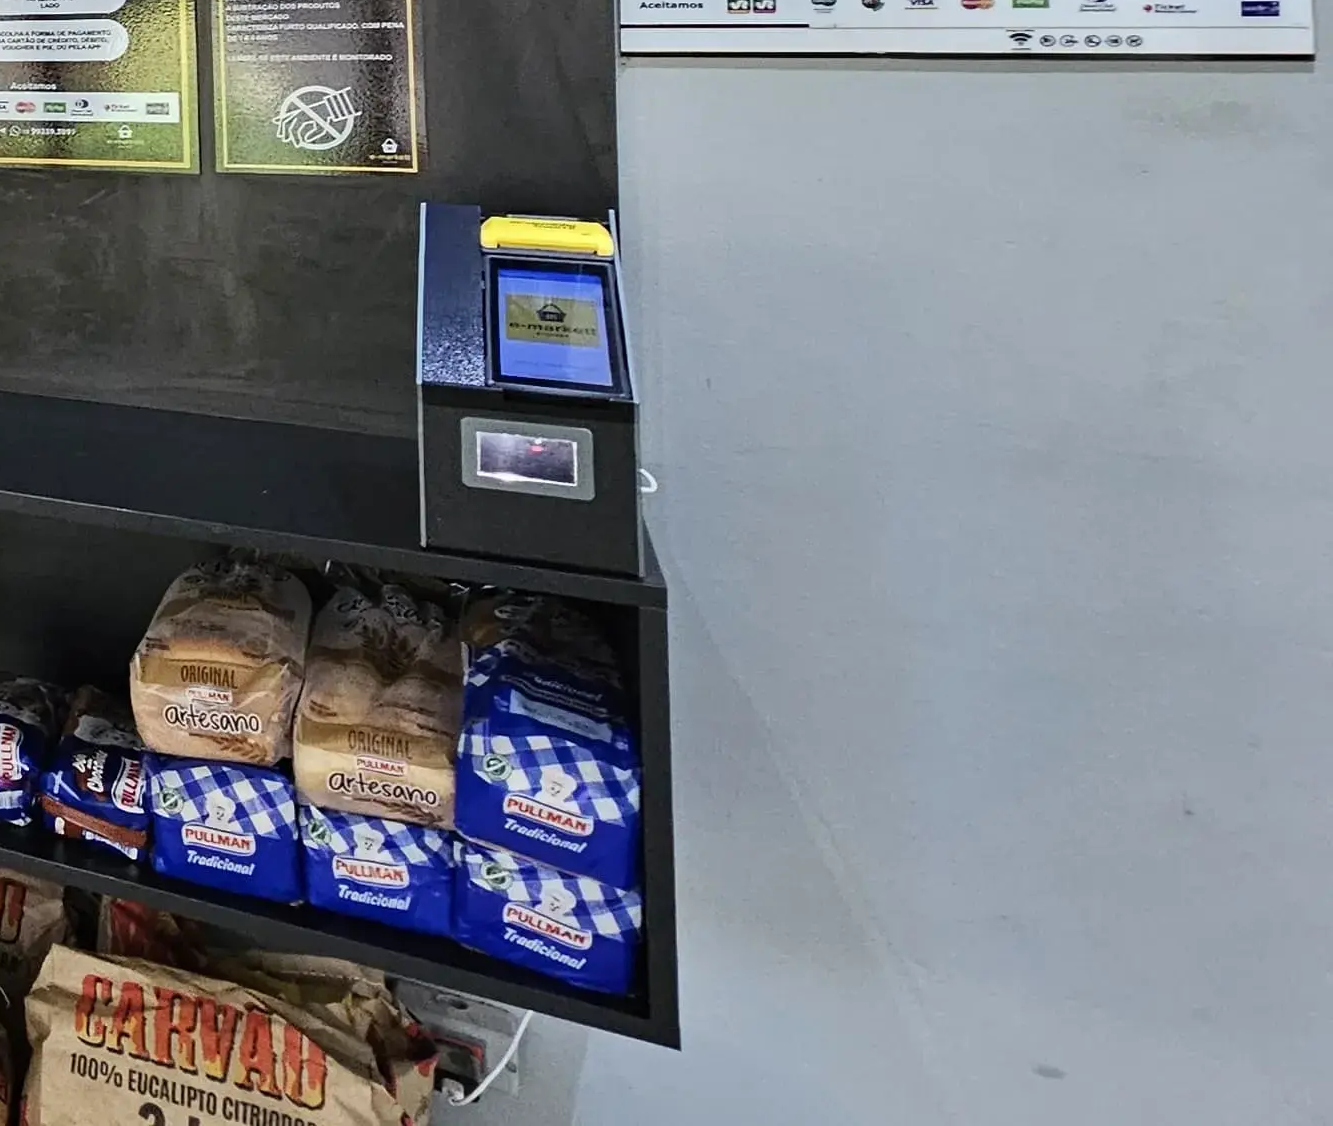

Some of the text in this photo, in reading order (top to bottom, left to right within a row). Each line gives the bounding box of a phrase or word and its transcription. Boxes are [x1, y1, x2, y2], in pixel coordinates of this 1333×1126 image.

[639, 0, 704, 11] Aceitamos
[180, 664, 238, 690] ORIGINAL
[164, 704, 260, 733] artesano
[348, 729, 413, 760] ORIGINAL
[328, 772, 438, 806] artesano
[507, 797, 590, 833] PULLMAN
[185, 827, 251, 851] PULLMAN
[504, 818, 587, 854] Tradicional
[186, 849, 255, 876] Tradicional
[336, 859, 405, 883] PULLMAN
[338, 884, 411, 911] Tradicional
[507, 906, 590, 945] PULLMAN
[504, 927, 587, 970] Tradicional
[70, 1052, 123, 1088] 100%
[128, 1070, 217, 1116] EUCALIPTO
